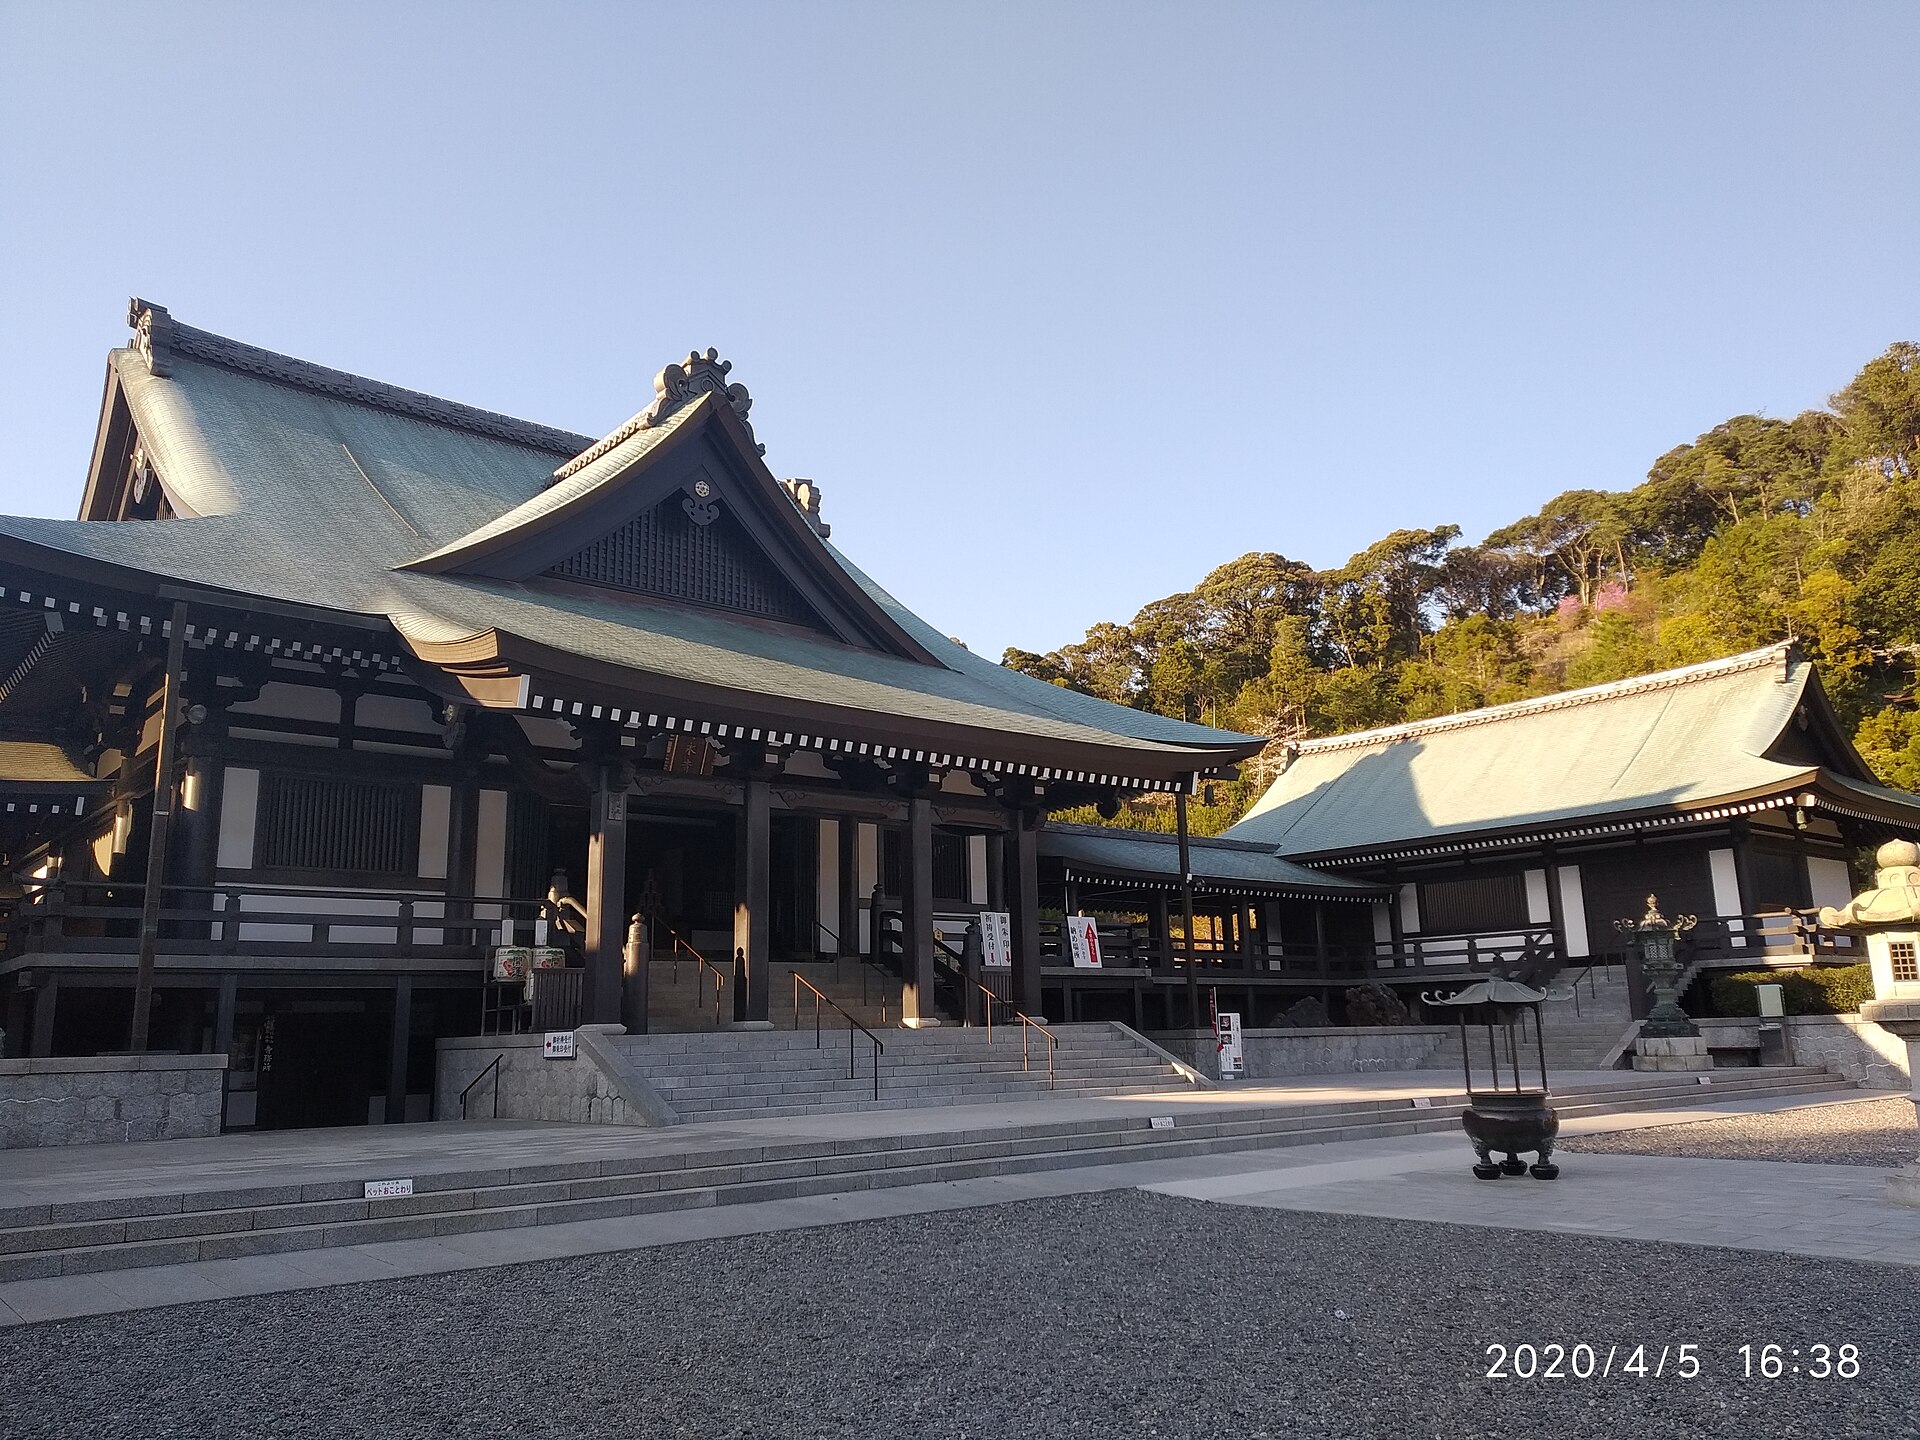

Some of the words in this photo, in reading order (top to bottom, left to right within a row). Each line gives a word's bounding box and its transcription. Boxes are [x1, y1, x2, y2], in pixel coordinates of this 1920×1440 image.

[1000, 915, 1010, 949] 御朱印
[367, 1185, 411, 1196] ペットおことわり
